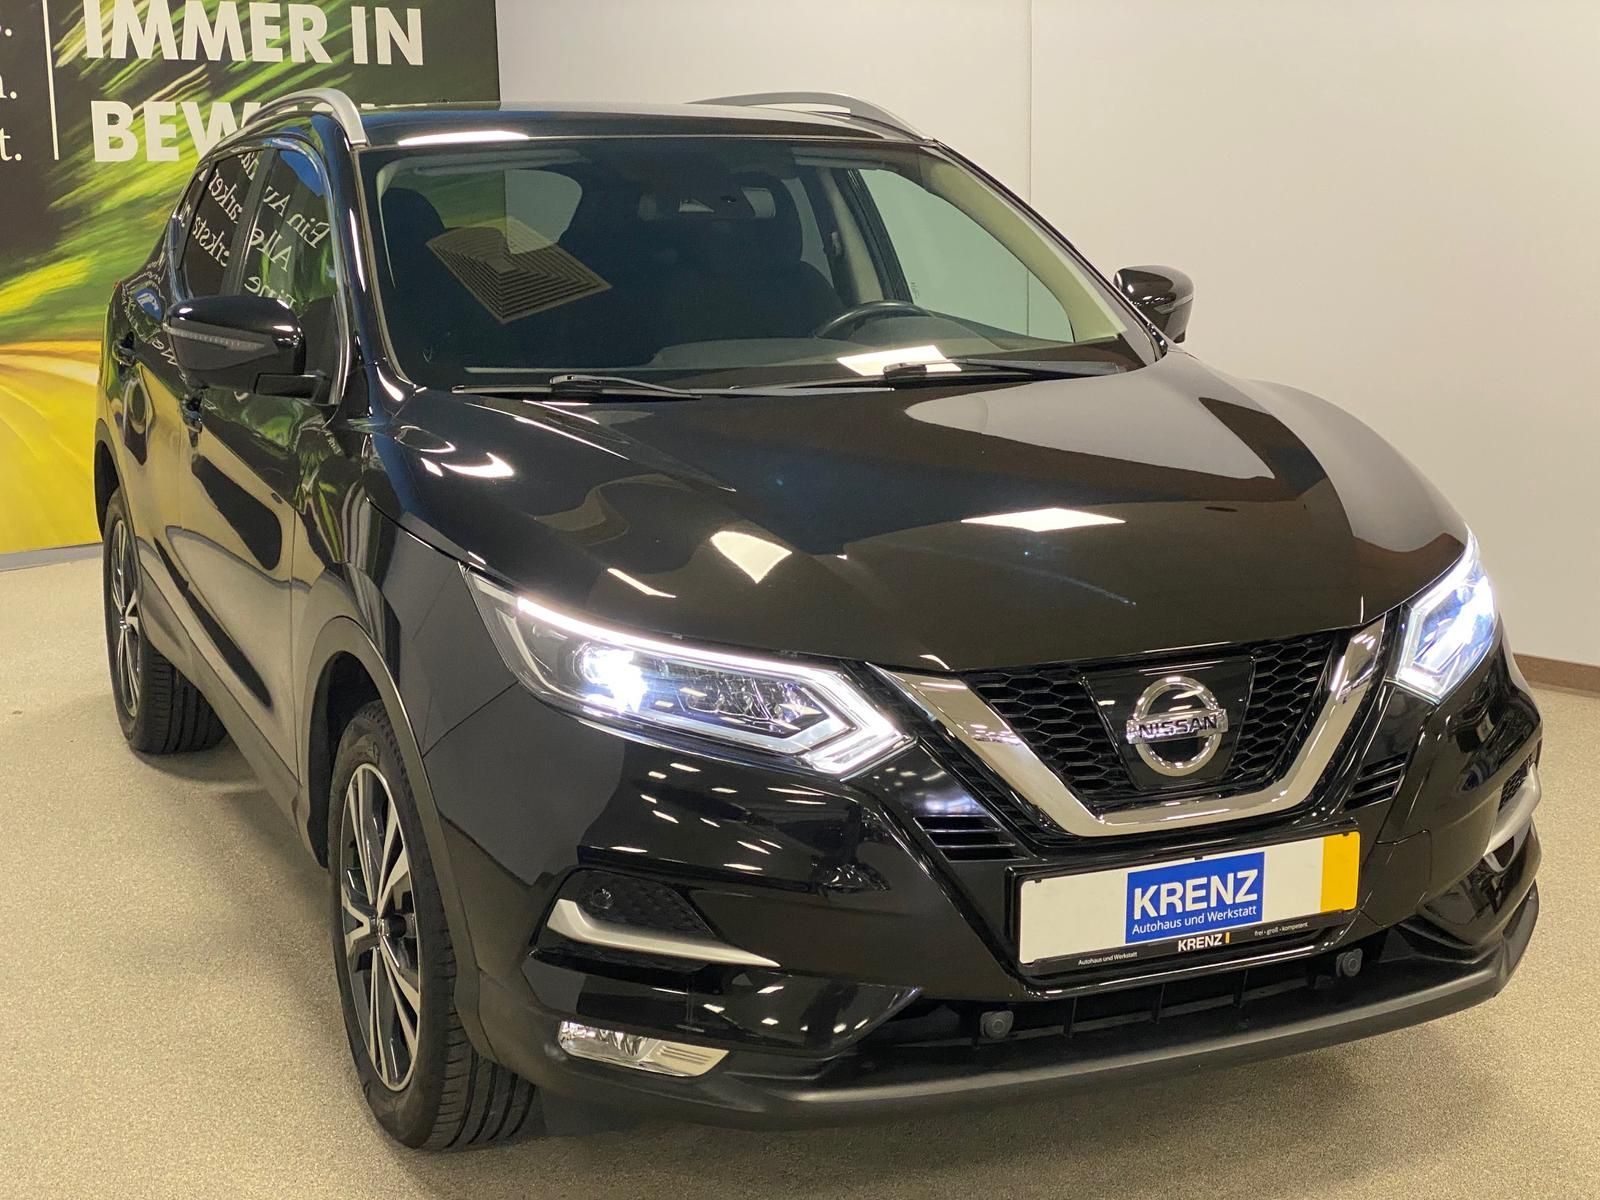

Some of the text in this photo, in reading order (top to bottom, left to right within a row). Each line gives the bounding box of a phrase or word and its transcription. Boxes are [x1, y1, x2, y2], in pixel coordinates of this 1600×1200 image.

[83, 0, 424, 66] IMMER IN
[1138, 715, 1218, 738] NISSAN
[1133, 869, 1259, 920] KRENZ
[1131, 905, 1257, 935] Autohaus und Werkstatt
[1177, 933, 1223, 953] KRENZ
[1077, 956, 1103, 967] Autohaus
